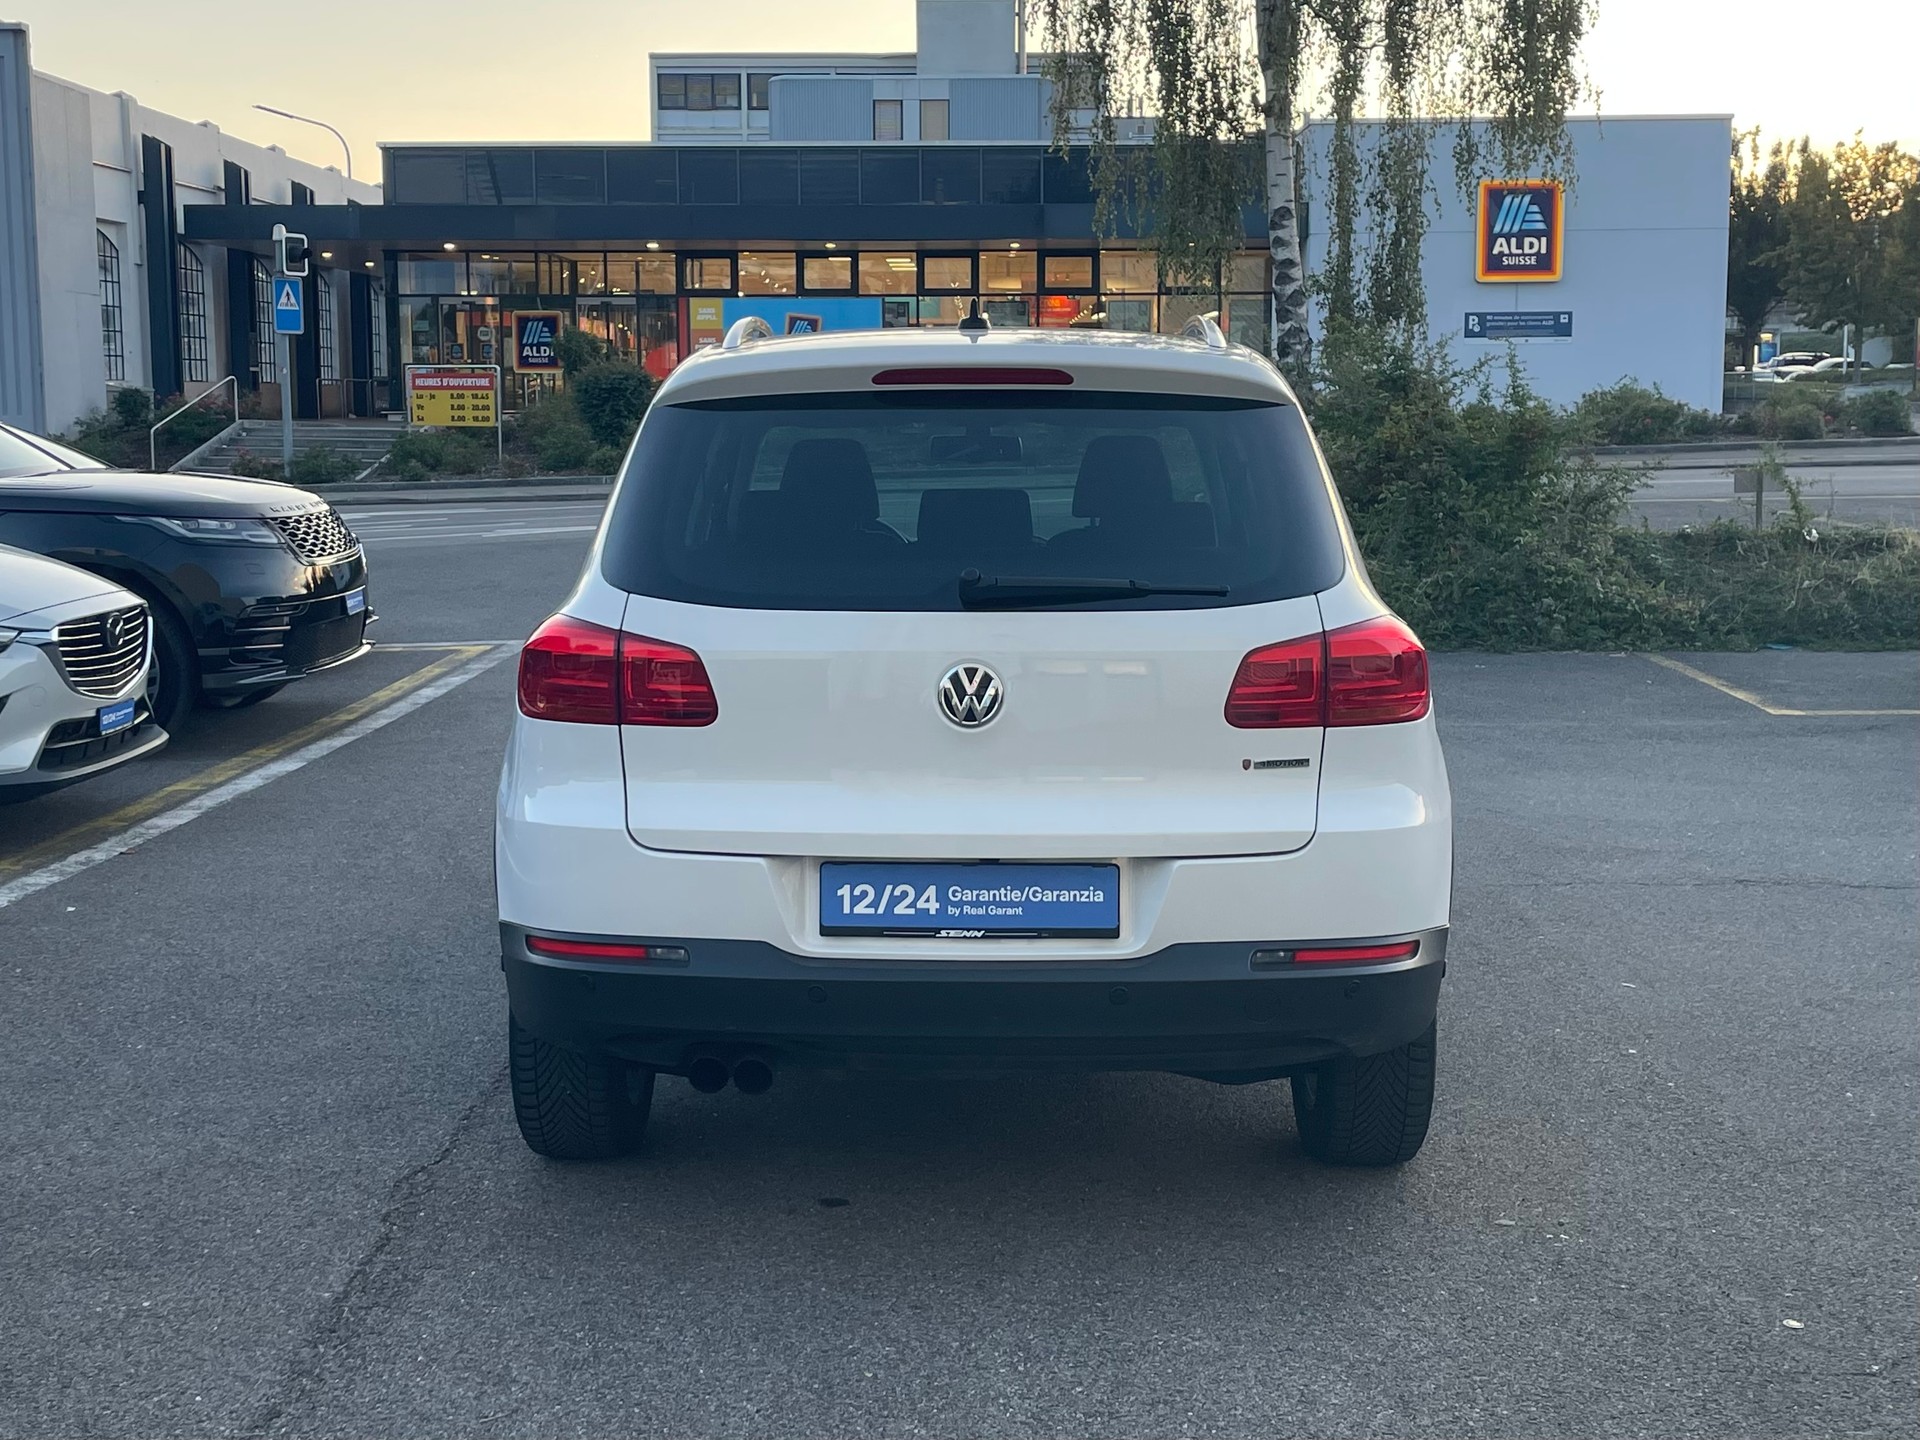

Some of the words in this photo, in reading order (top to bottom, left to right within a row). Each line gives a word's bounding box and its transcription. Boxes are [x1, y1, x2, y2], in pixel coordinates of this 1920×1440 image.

[1492, 236, 1547, 255] ALDI
[1502, 255, 1537, 265] SUISSE
[415, 377, 442, 386] HEURES
[442, 377, 490, 386] D'OUVERTURE
[837, 883, 940, 915] 12/24
[948, 886, 1104, 902] Garantie/Garanzia
[947, 905, 961, 917] by
[963, 905, 985, 915] Real
[988, 905, 1023, 915] Garant
[935, 930, 986, 938] SENN
